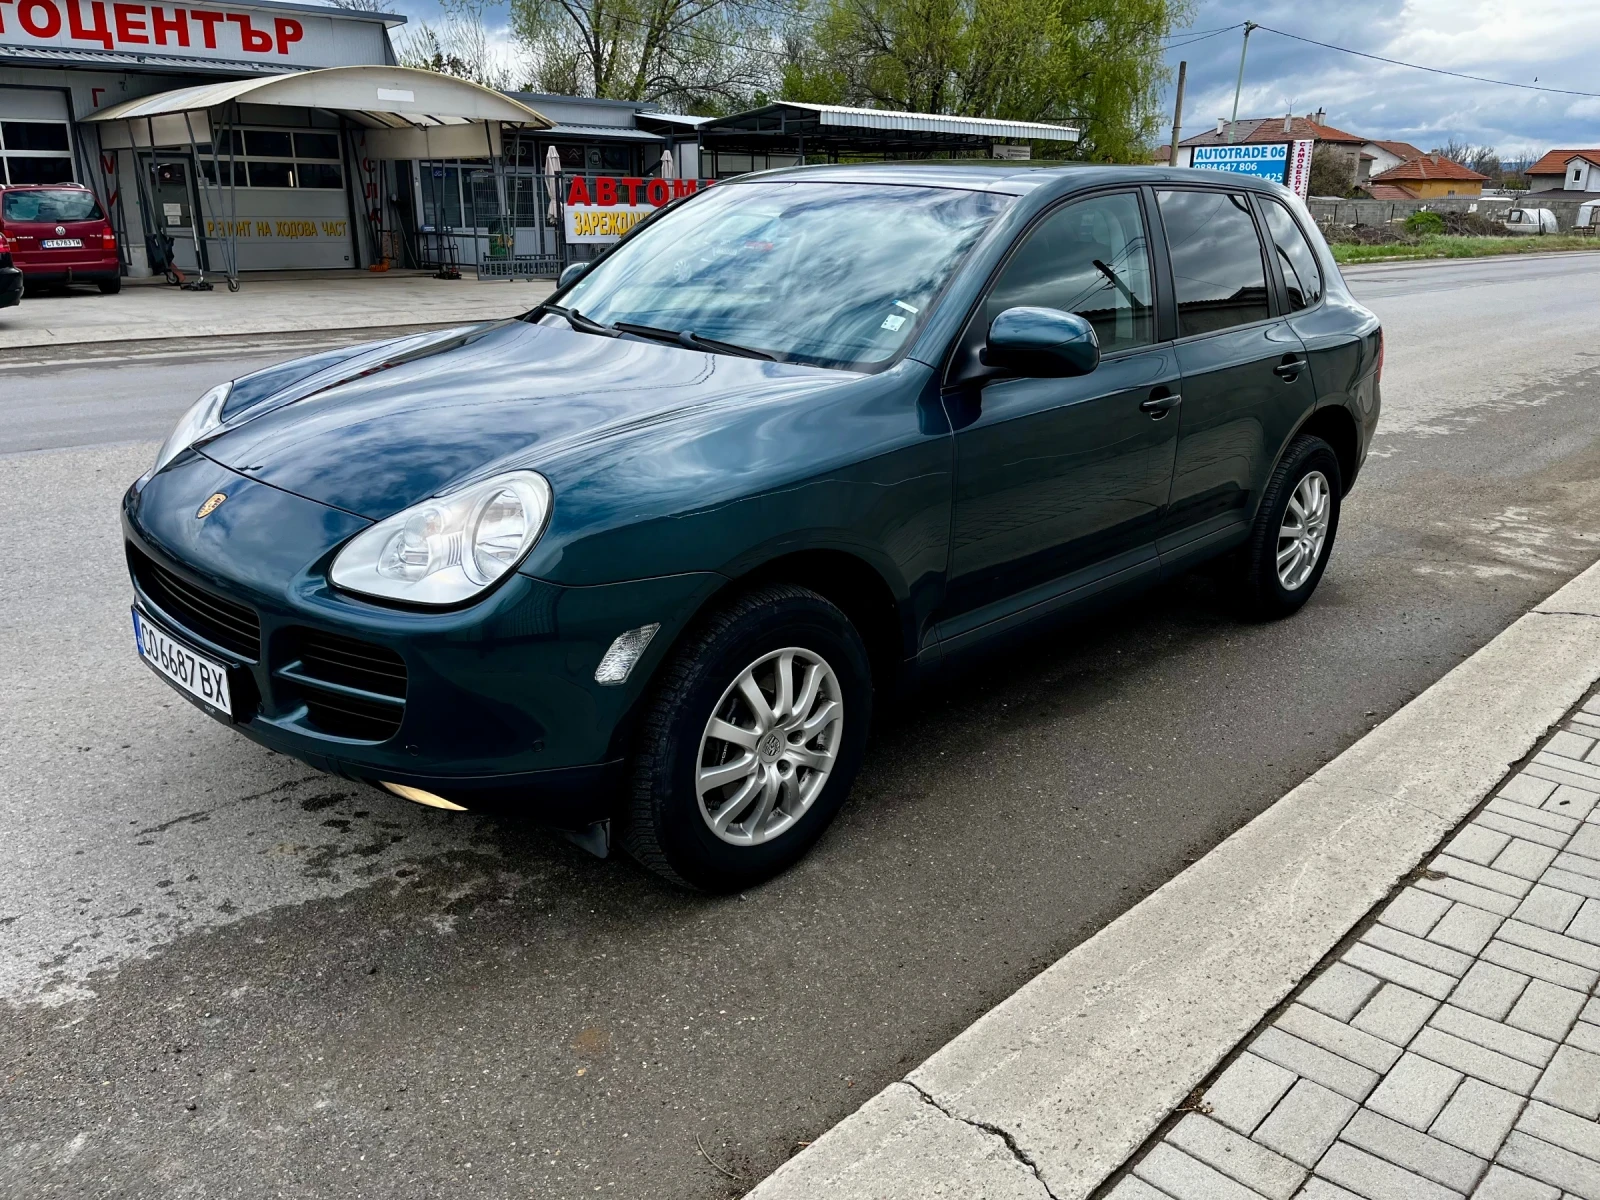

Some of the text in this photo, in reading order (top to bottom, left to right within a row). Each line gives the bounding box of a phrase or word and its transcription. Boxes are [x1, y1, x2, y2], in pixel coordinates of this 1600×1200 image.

[1196, 146, 1286, 160] AUTOTRADE 06
[1219, 162, 1237, 171] 647
[1239, 162, 1258, 171] 806
[1265, 173, 1283, 182] 425
[256, 221, 272, 237] НА
[275, 221, 318, 239] ХОДОВА
[321, 220, 347, 237] ЧАСТ
[573, 211, 651, 238] ЗАРЕЖДА
[141, 622, 159, 662] CO
[160, 637, 196, 688] 6687
[199, 661, 227, 708] BX
